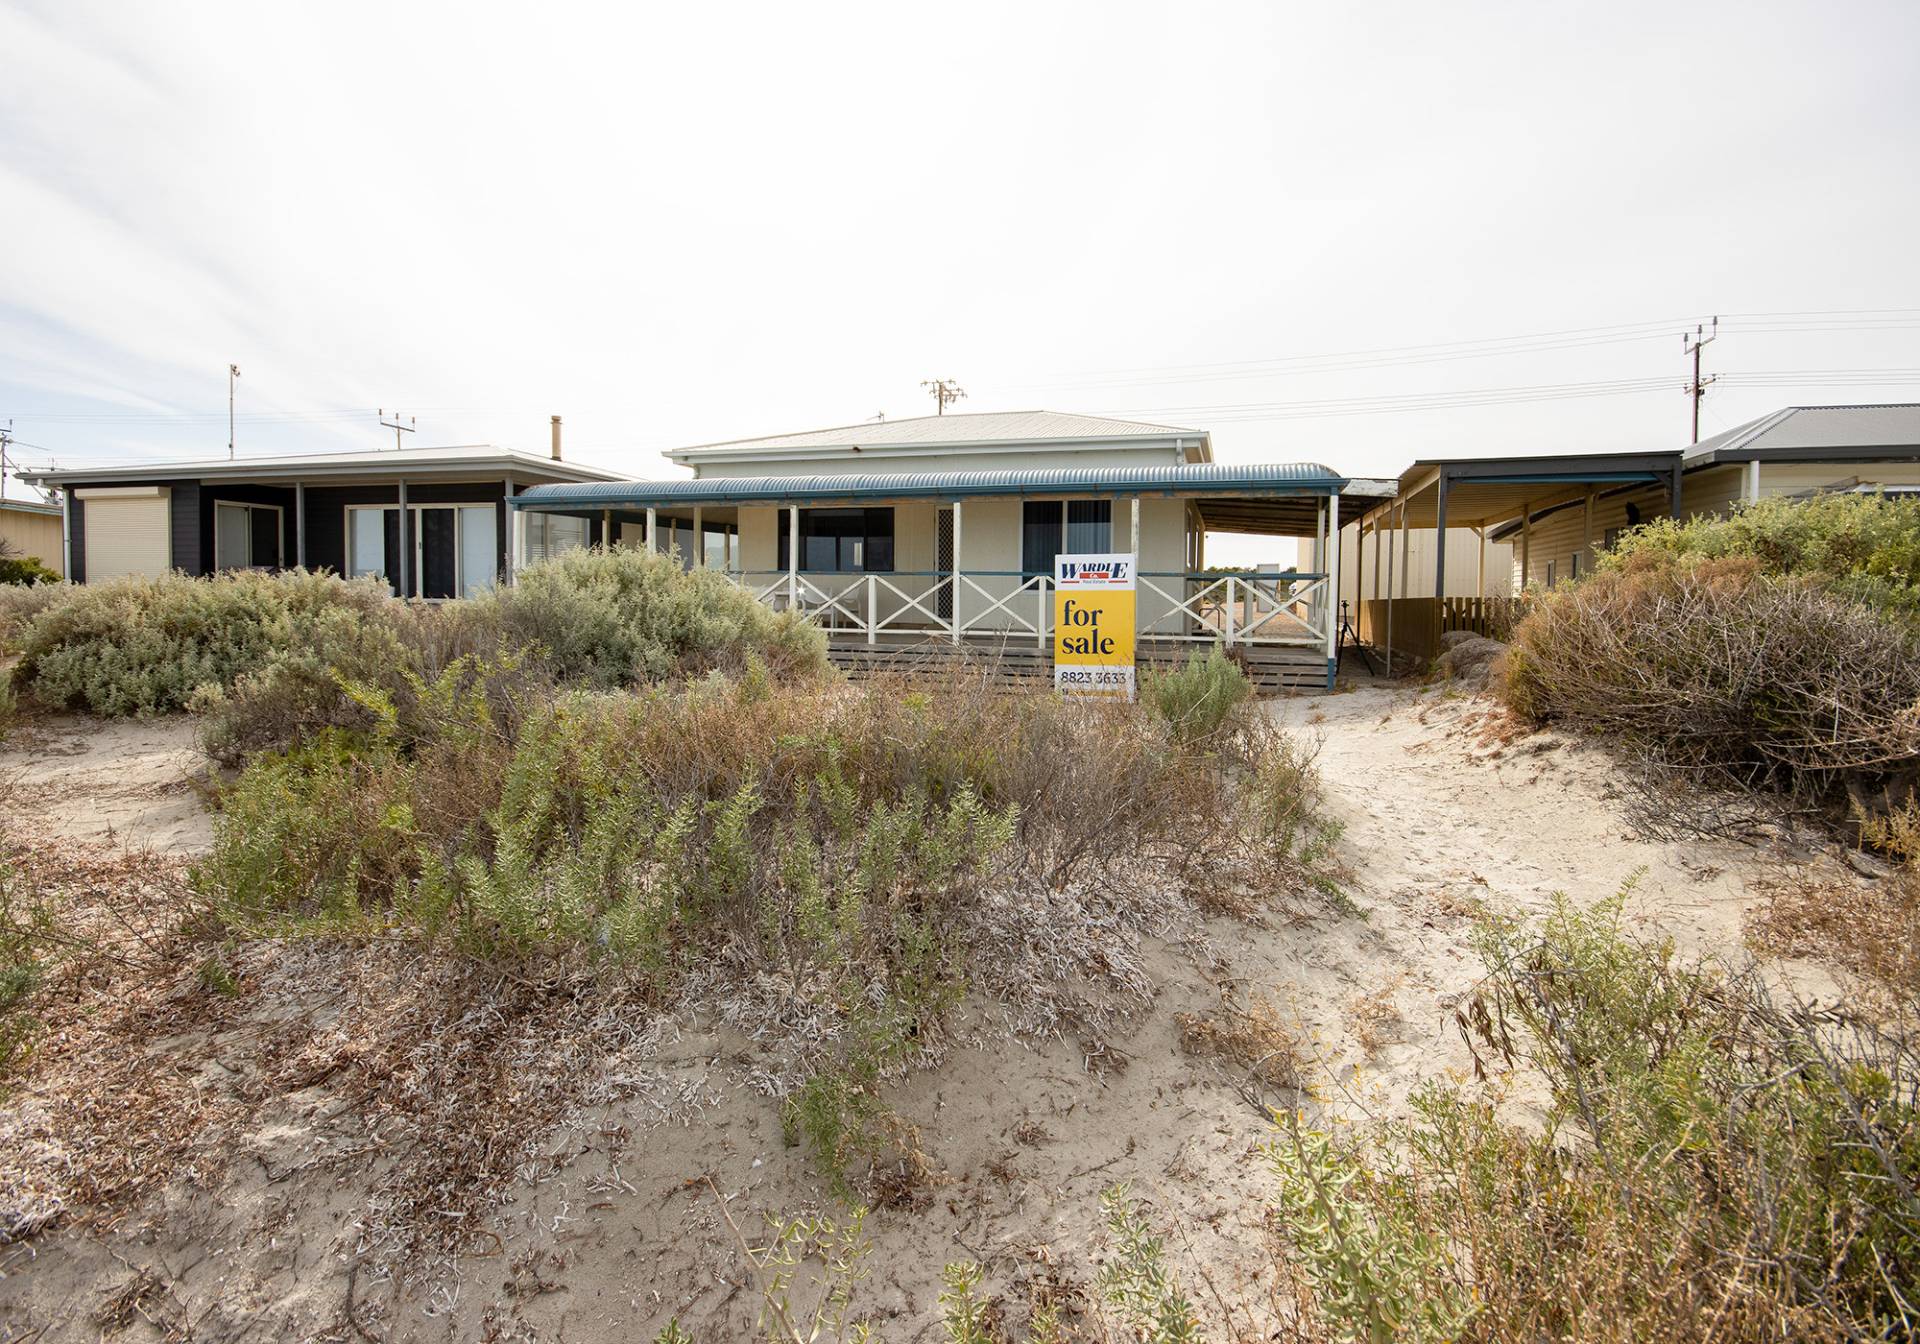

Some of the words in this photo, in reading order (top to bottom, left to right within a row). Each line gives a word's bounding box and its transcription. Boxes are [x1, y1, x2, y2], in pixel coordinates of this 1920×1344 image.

[1062, 562, 1128, 579] WARDLE
[1063, 600, 1103, 626] for
[1062, 628, 1115, 655] sale
[1061, 671, 1092, 684] 8823
[1095, 672, 1126, 684] 3633
